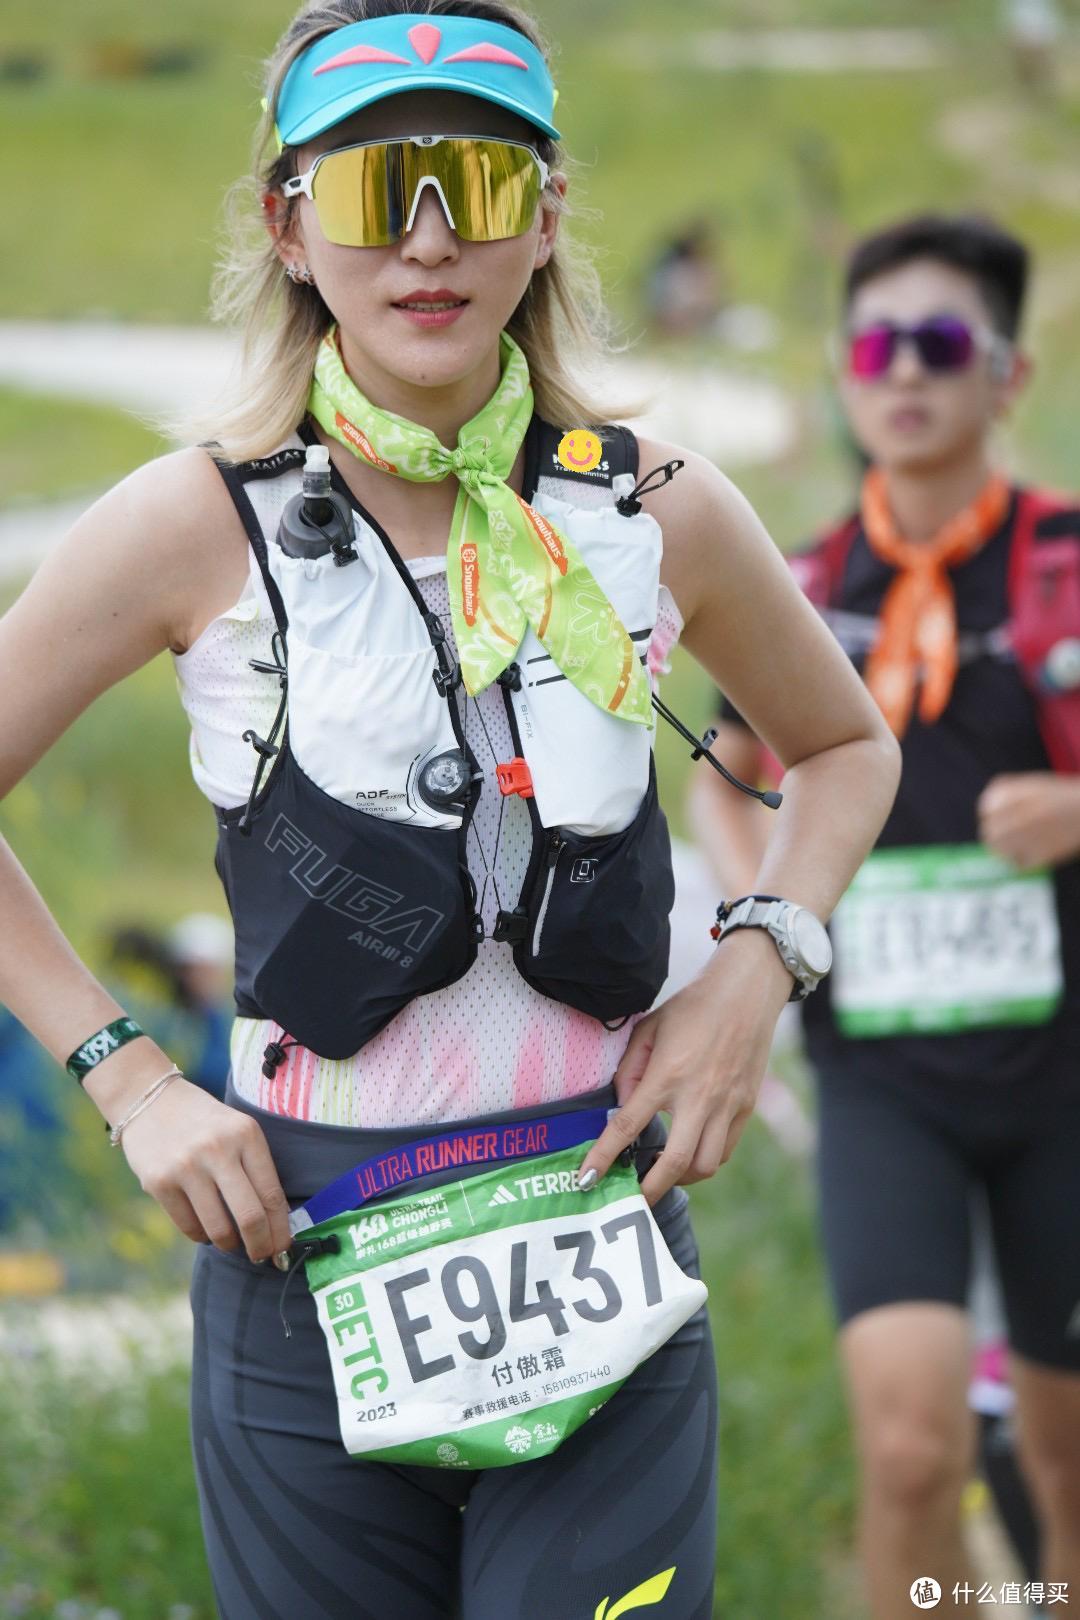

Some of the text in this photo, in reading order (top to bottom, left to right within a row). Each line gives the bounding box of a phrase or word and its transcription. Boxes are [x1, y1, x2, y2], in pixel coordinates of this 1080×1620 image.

[464, 564, 475, 617] Snowhaus
[355, 789, 389, 800] ADF
[264, 812, 445, 953] FUGA
[399, 955, 414, 969] 8
[357, 1124, 549, 1199] ULTRA RUNNER GEAR
[514, 1168, 597, 1200] TERRE
[392, 1201, 449, 1228] CHONGLI
[334, 1291, 355, 1312] 30
[383, 1209, 664, 1384] E9437
[332, 1311, 389, 1400] ETC
[491, 1346, 566, 1388] 付傲霜
[356, 1401, 397, 1422] 2023
